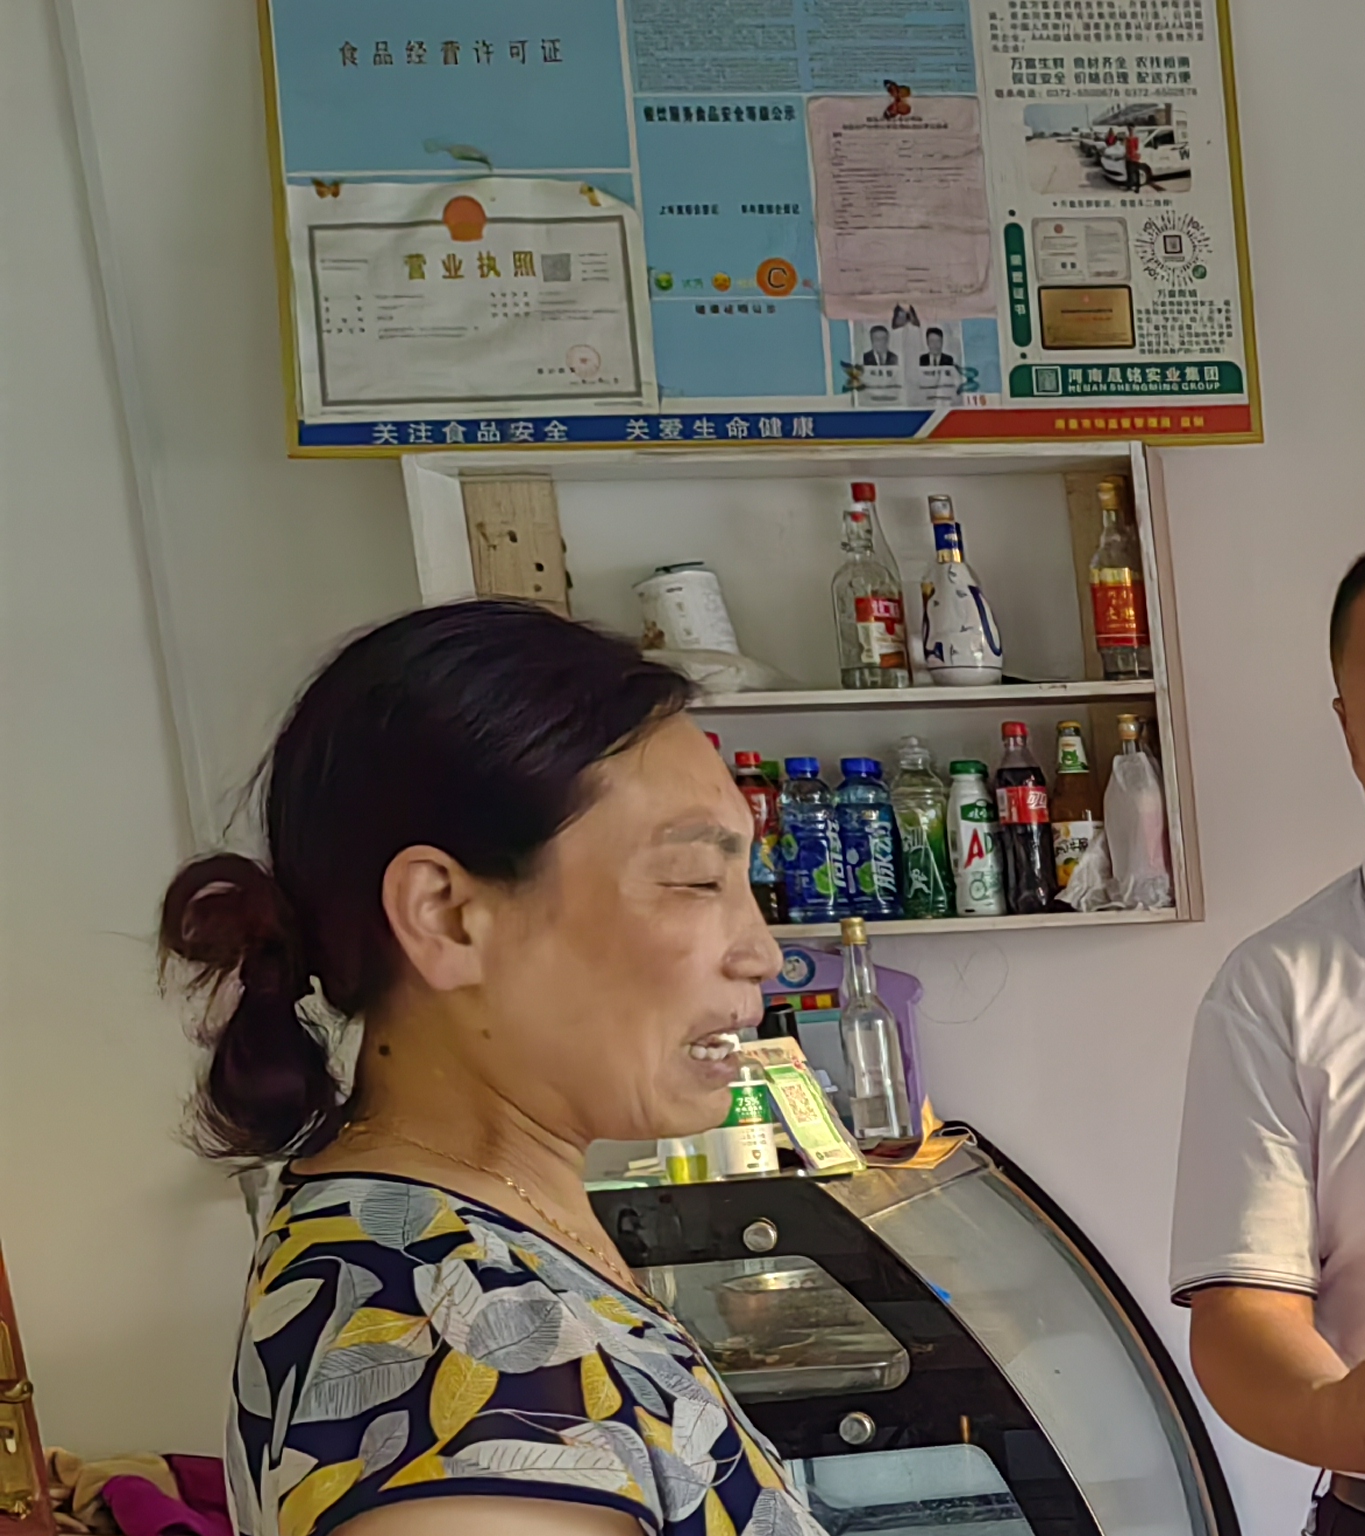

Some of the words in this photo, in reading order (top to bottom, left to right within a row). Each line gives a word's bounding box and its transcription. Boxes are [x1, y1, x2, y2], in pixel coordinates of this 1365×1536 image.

[338, 38, 564, 67] 食品经营许可证
[404, 251, 536, 280] 营业执照
[372, 420, 570, 445] 关注食品安全
[625, 416, 816, 441] 关爱生命健康
